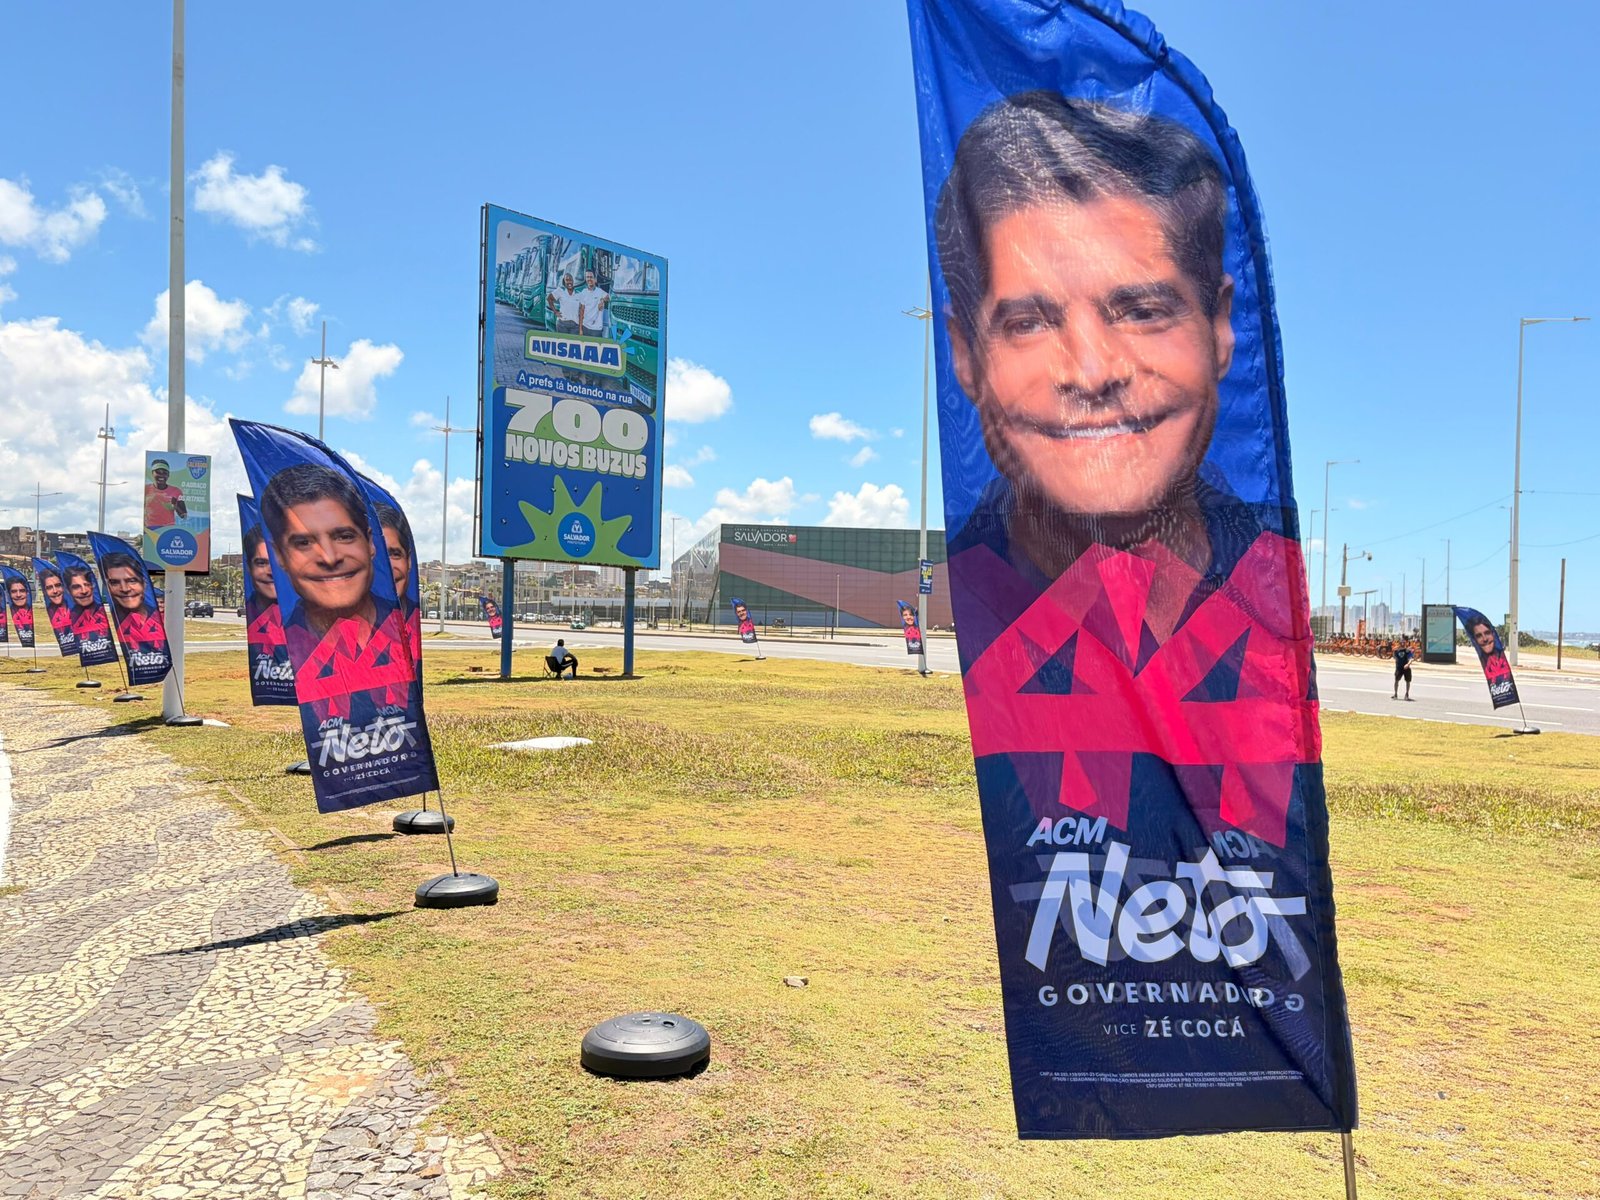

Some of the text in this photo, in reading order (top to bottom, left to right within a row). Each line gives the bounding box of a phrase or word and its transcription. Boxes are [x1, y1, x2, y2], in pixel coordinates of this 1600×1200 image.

[532, 339, 620, 366] AVISAAA
[519, 375, 526, 383] A
[528, 376, 553, 391] prefs
[555, 380, 564, 390] tá
[567, 383, 603, 398] botando
[605, 391, 616, 401] na
[619, 395, 633, 404] rua
[505, 389, 649, 451] 700
[505, 434, 647, 478] NOVOS BUZUS
[734, 530, 788, 544] SALVADOR
[161, 548, 193, 556] SALVADOR
[318, 716, 344, 731] ACM
[319, 716, 416, 767] Neto
[1026, 816, 1107, 847] ACM
[1025, 841, 1307, 972] Neto
[1102, 1015, 1245, 1038] VICE ZÉ COCÁ
